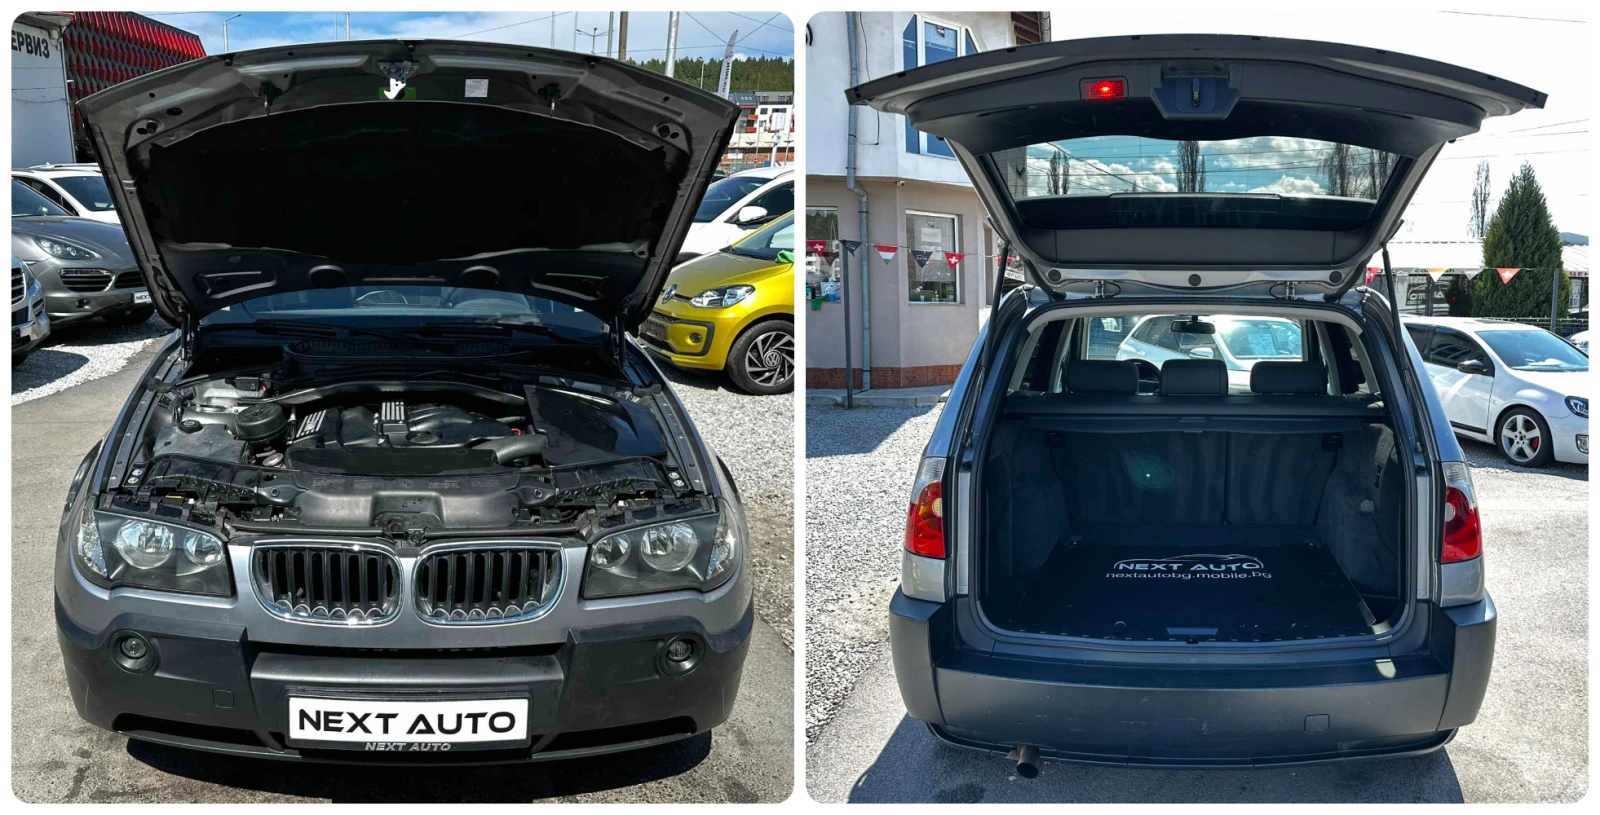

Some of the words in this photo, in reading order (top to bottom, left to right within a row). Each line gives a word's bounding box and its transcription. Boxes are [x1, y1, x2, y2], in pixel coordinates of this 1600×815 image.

[1190, 562, 1260, 571] AUTO
[1106, 571, 1272, 580] nextautobg.mobile.bg
[299, 708, 398, 735] NEXT
[406, 711, 516, 735] AUTO
[365, 742, 408, 751] NEXT
[409, 742, 452, 751] AUTO
